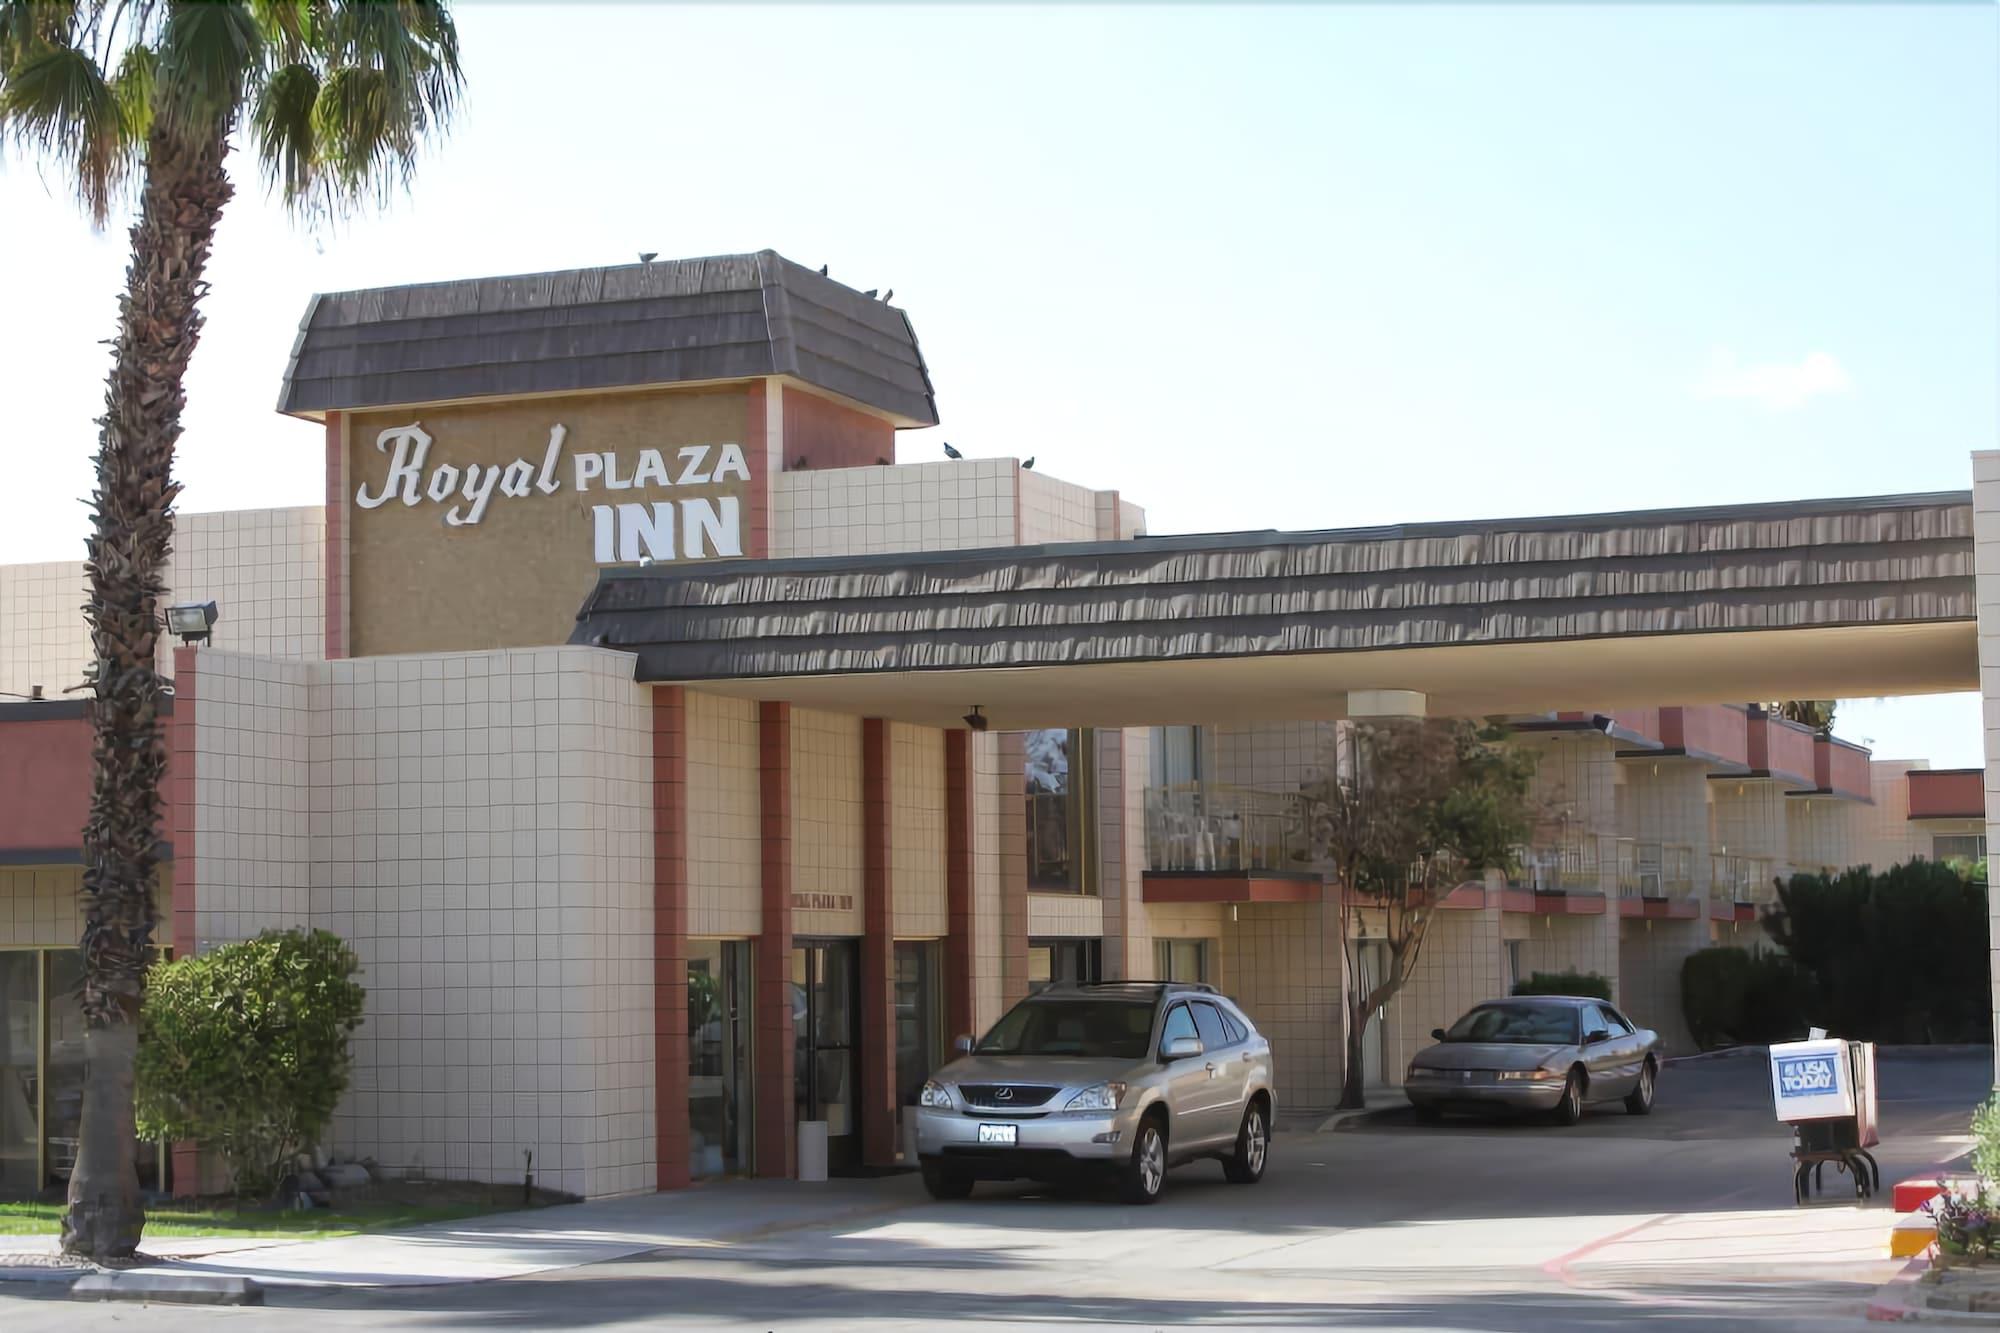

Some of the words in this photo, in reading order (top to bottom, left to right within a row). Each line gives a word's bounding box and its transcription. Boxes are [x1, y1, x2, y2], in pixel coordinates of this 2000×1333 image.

[356, 421, 567, 526] Royal
[574, 443, 751, 491] PLAZA
[592, 496, 743, 563] INN
[1782, 1073, 1832, 1091] TODAY
